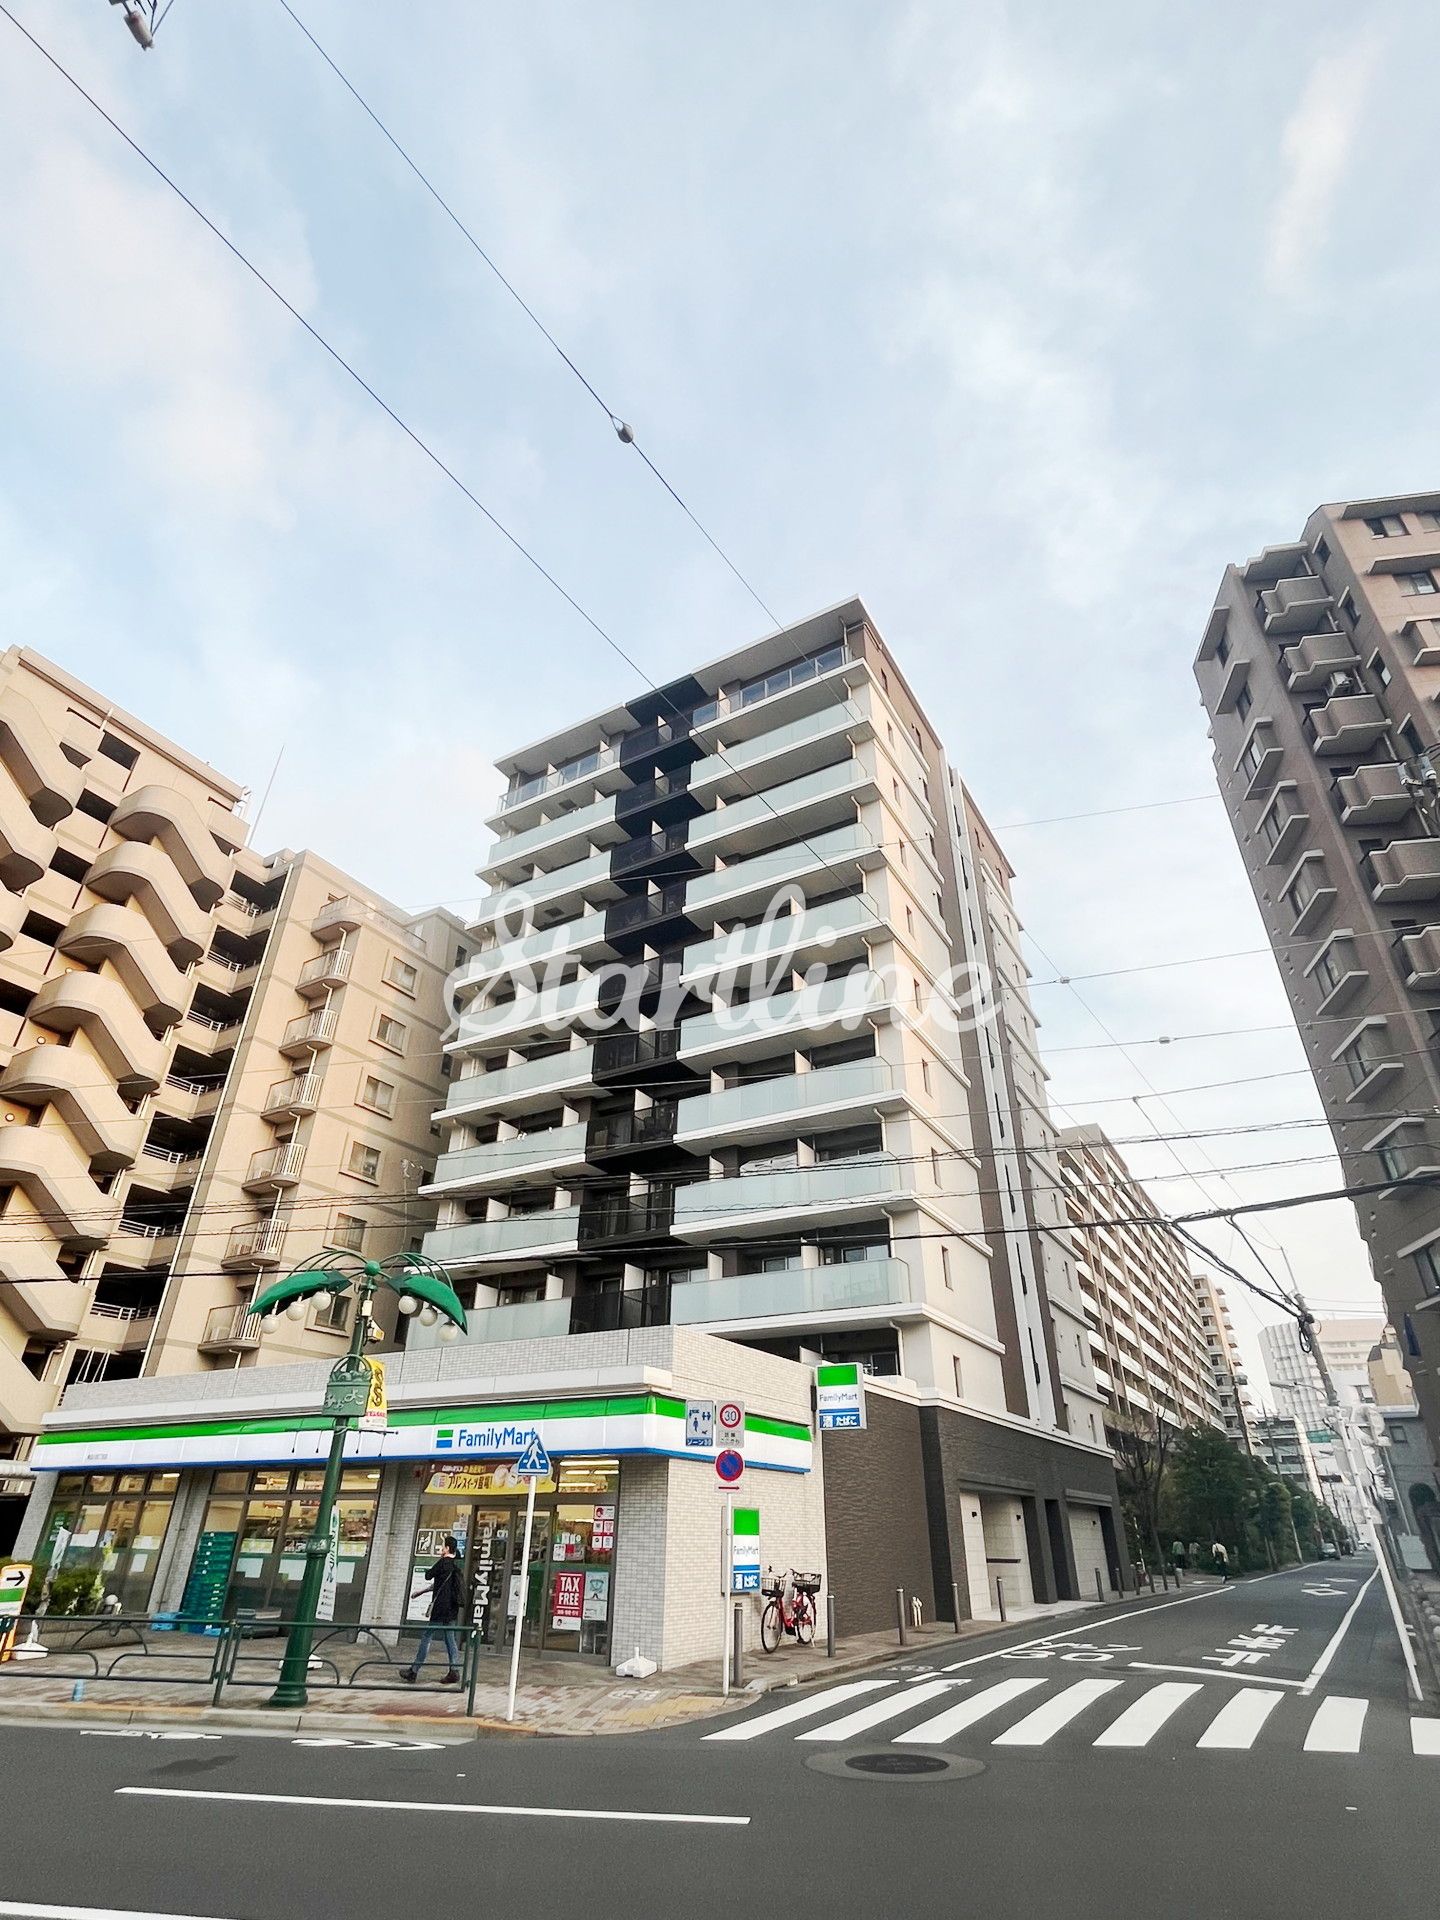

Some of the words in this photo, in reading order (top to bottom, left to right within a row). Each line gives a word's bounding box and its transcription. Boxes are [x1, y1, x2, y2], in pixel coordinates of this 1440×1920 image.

[819, 1392, 858, 1402] FamilyMart
[724, 1410, 737, 1422] 30
[836, 1415, 857, 1427] たばこ
[458, 1427, 537, 1450] FamilyMart
[560, 1576, 580, 1593] TAX
[558, 1591, 580, 1606] FREE
